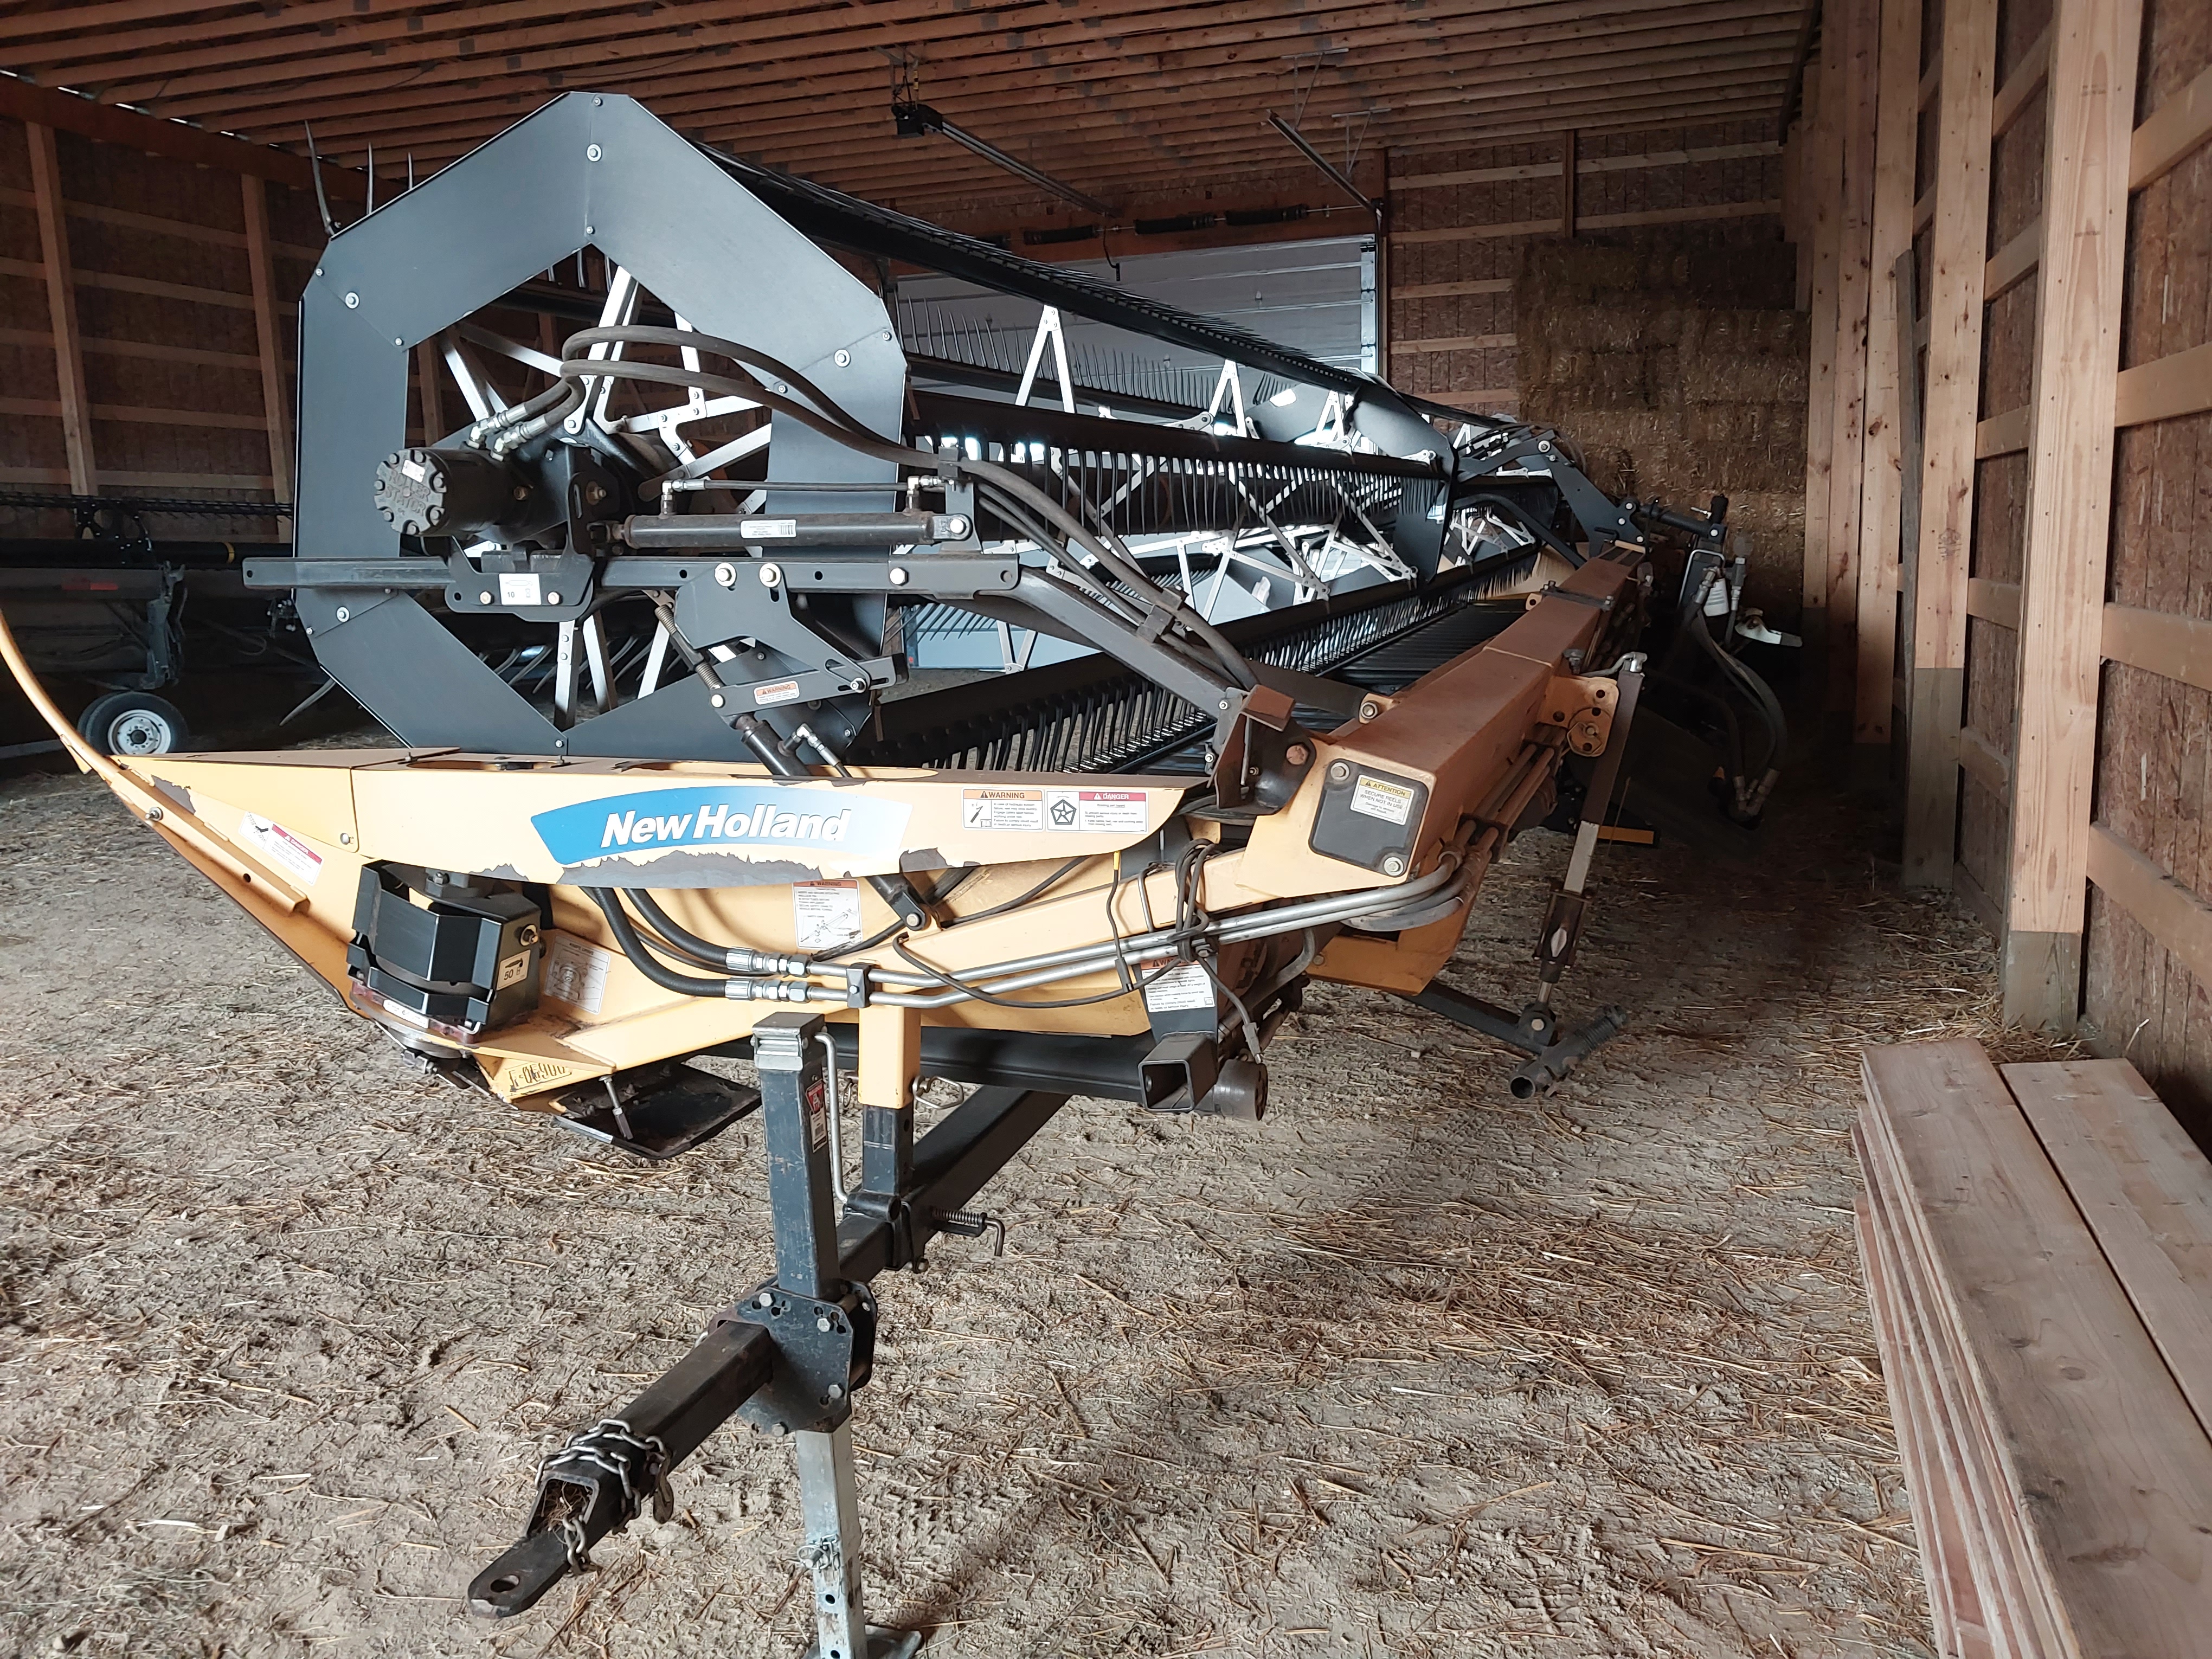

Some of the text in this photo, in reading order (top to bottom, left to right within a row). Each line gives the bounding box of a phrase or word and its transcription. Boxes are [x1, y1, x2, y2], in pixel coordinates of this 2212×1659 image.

[1373, 783, 1405, 796] ATTENTION
[1365, 790, 1401, 803] SECURE REELS
[600, 803, 852, 848] New Holland
[504, 969, 513, 980] 50
